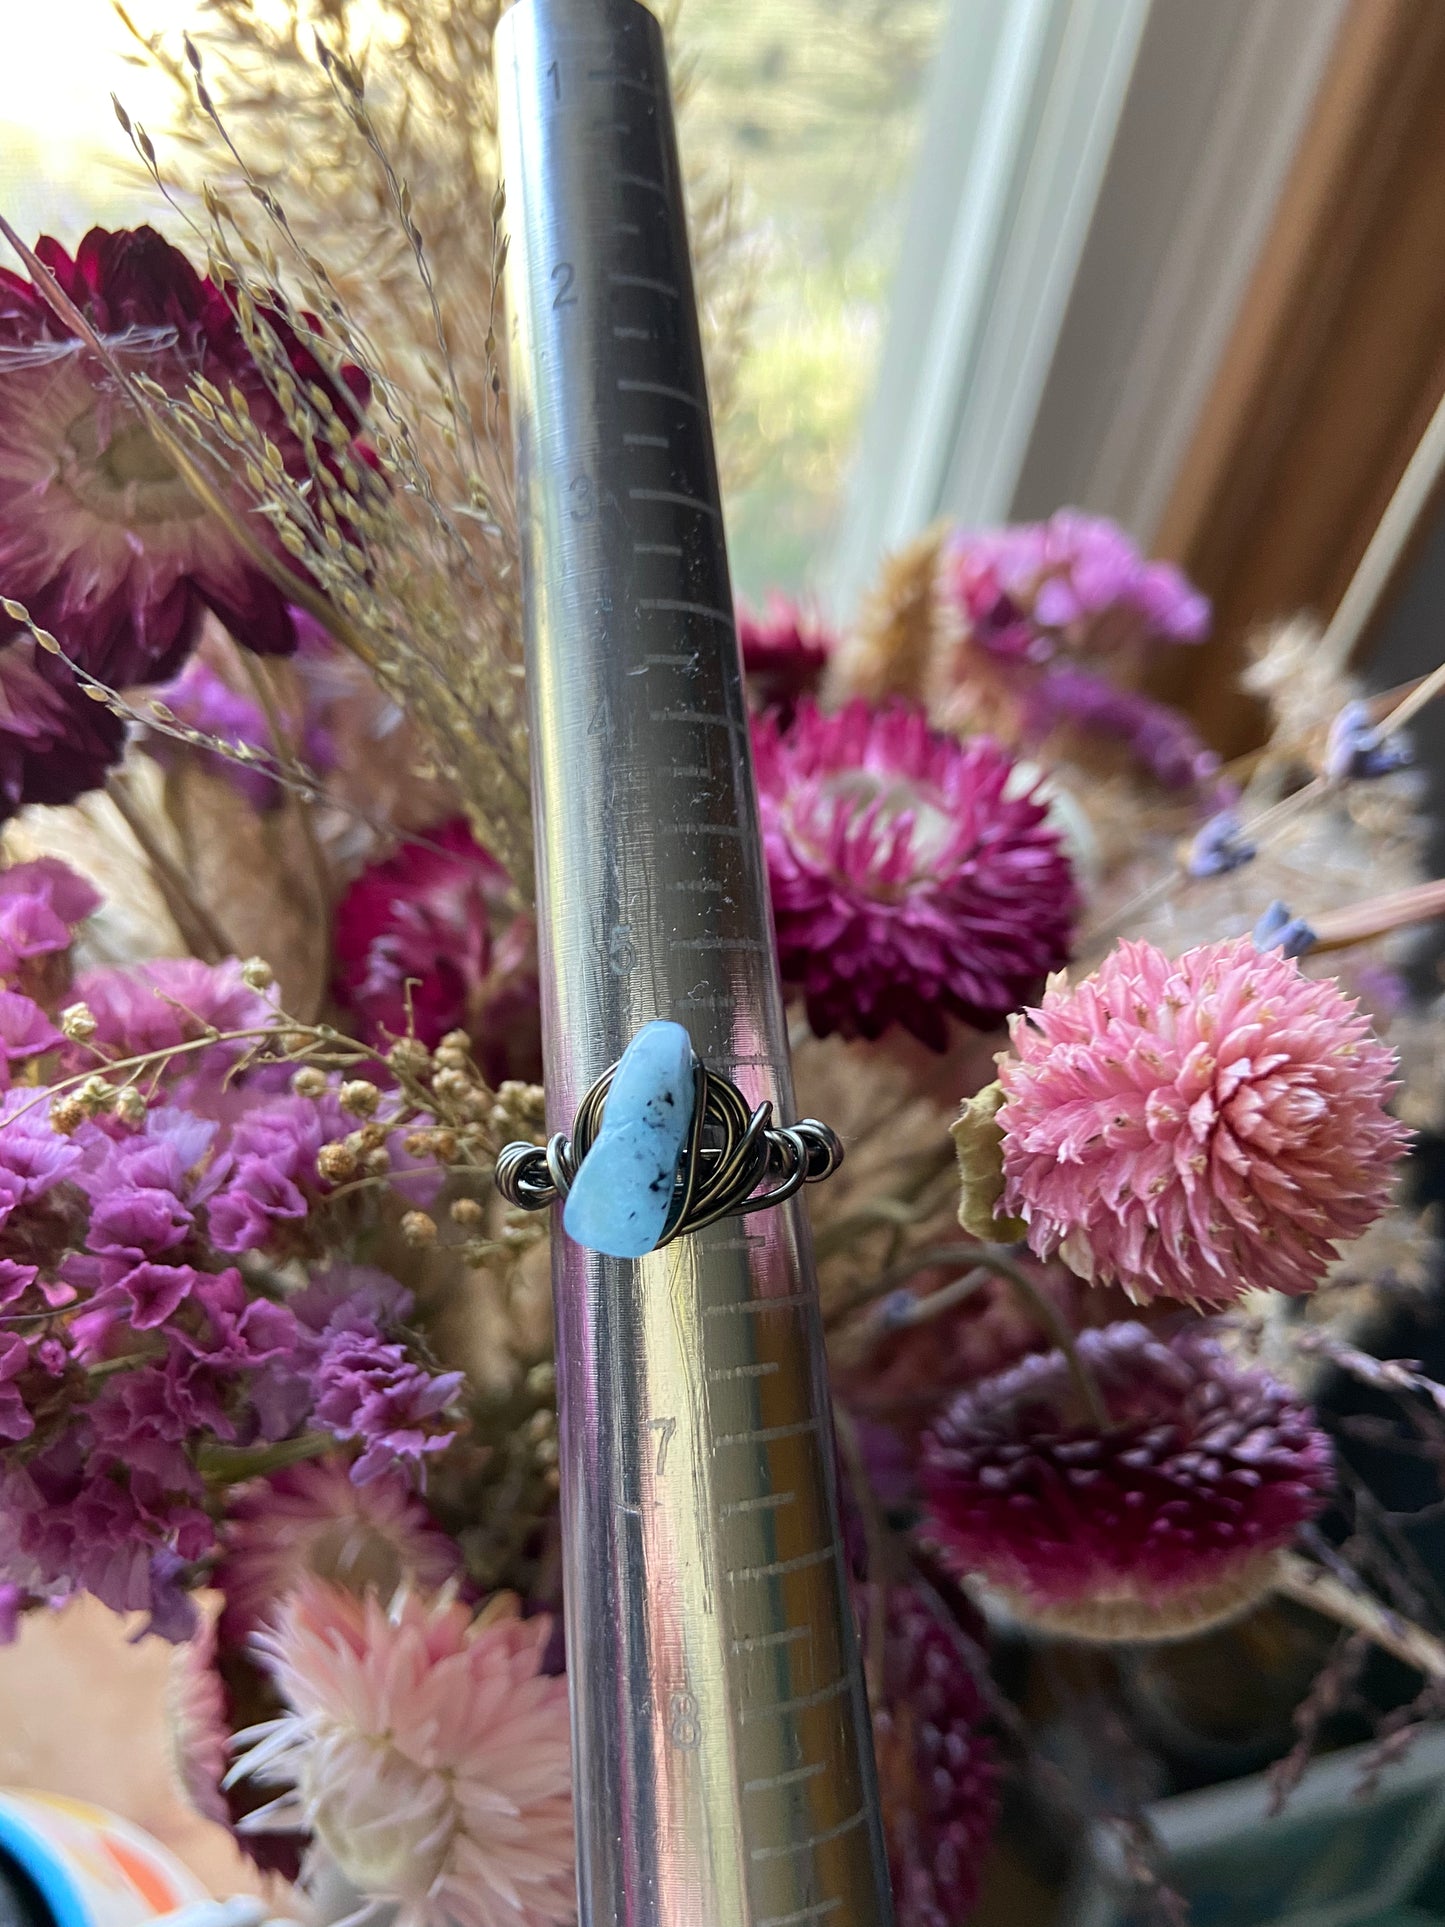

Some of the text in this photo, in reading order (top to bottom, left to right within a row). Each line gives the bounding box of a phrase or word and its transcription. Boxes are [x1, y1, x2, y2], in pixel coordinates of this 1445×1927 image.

[547, 61, 563, 101] 1
[550, 262, 578, 310] 2
[568, 474, 597, 522] 3
[587, 696, 611, 742] 4
[608, 924, 638, 976] 5
[647, 1416, 677, 1477] 7
[670, 1693, 701, 1752] 8
